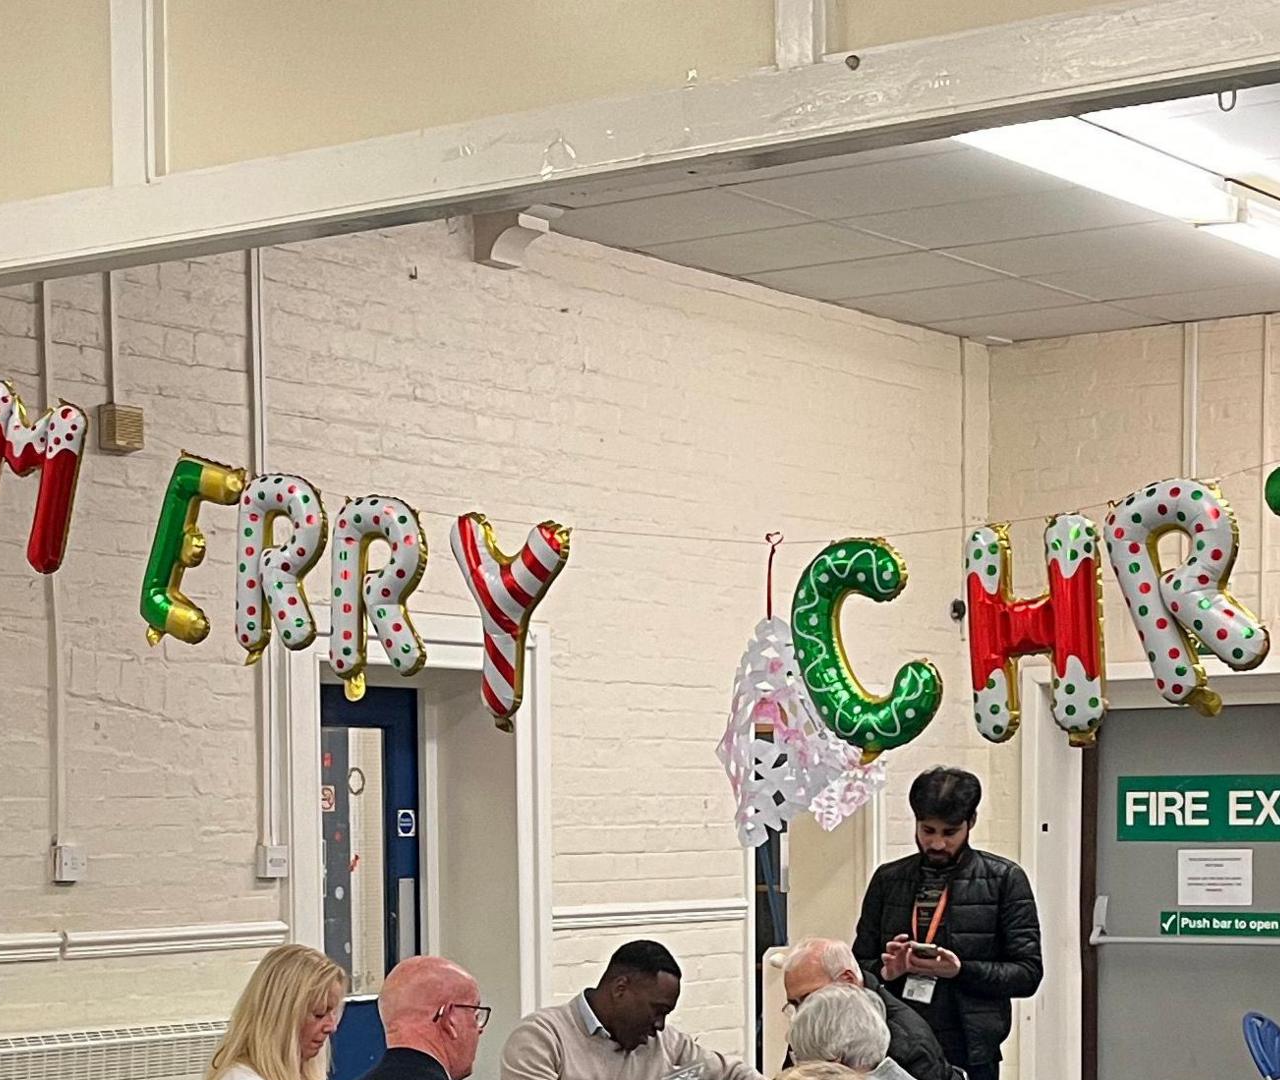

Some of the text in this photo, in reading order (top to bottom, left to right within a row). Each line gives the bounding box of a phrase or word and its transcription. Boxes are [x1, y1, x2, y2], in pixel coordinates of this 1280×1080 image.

[1125, 791, 1210, 826] FIRE
[1180, 917, 1279, 932] Push bar to open
